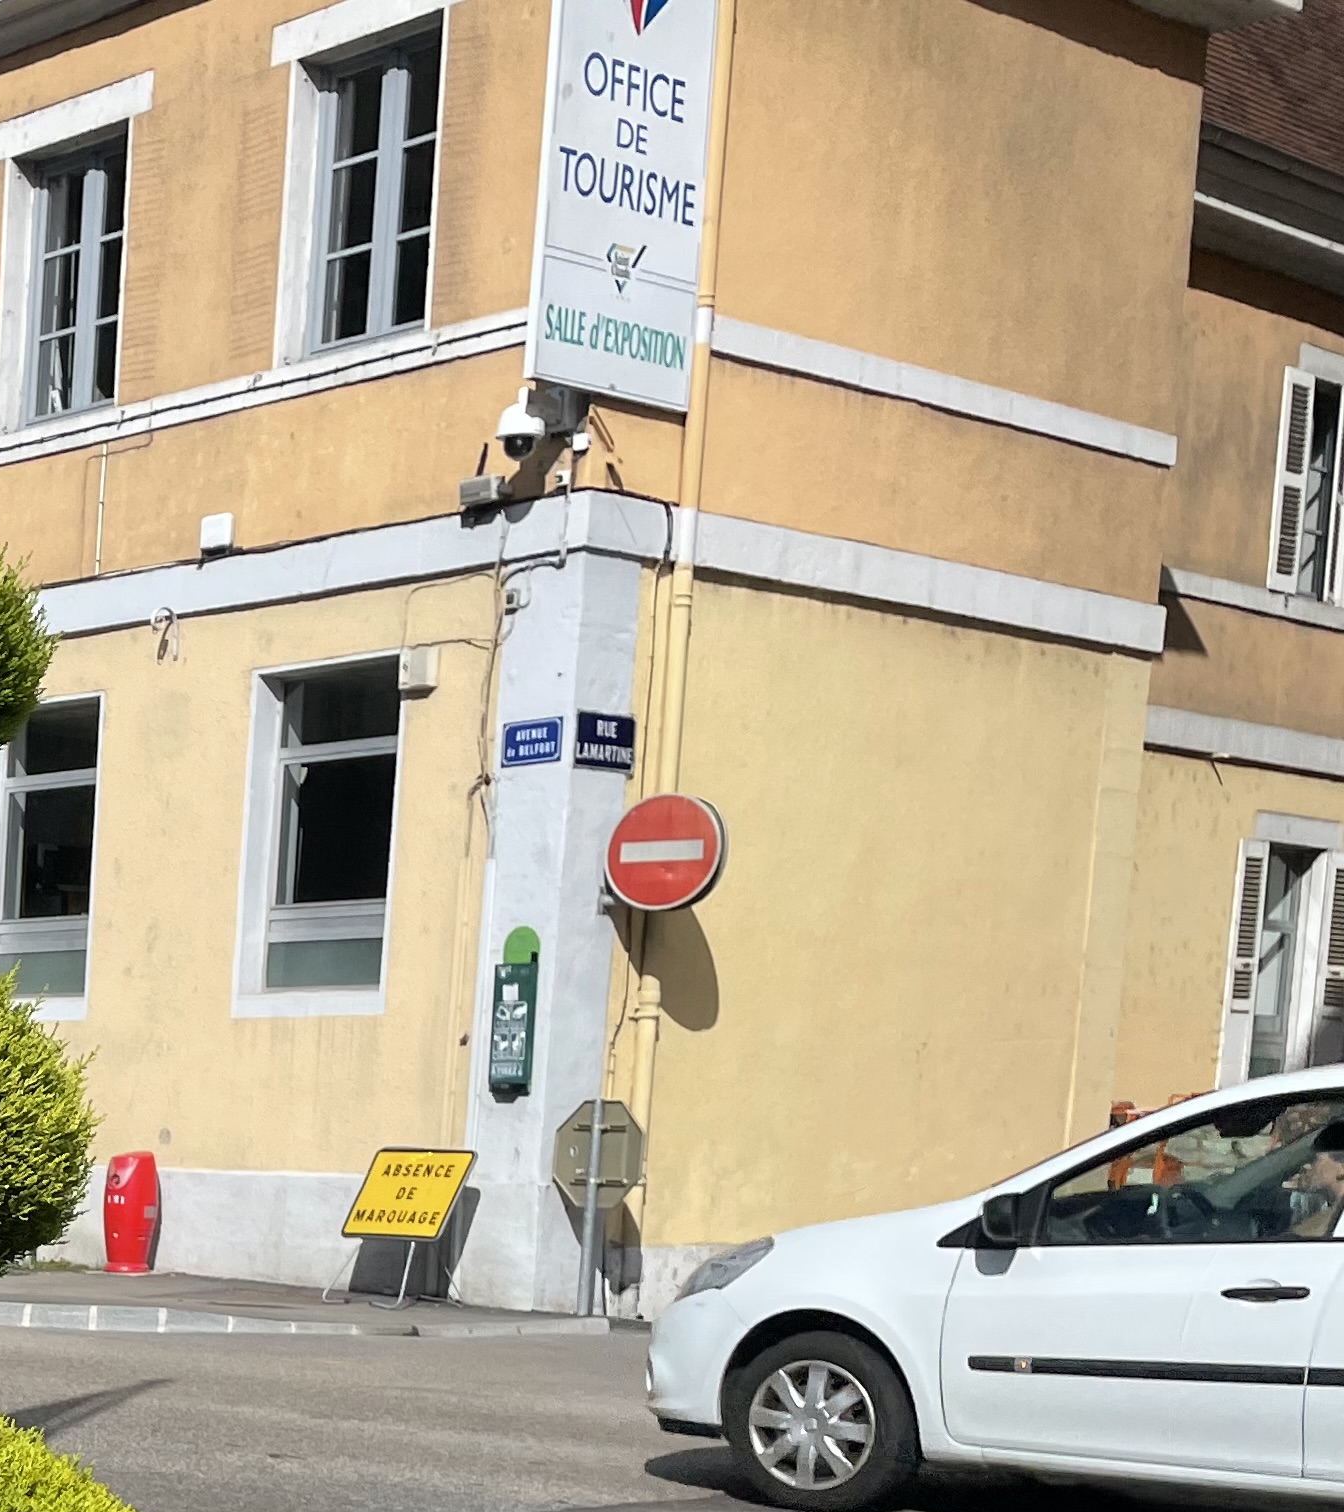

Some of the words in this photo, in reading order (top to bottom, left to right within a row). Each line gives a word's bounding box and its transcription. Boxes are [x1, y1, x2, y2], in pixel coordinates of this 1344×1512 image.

[584, 51, 686, 123] OFFICE
[616, 118, 648, 155] DE
[559, 146, 697, 227] TOURISME
[544, 303, 586, 347] SALLE
[590, 313, 686, 371] d'EXPOSITION
[516, 727, 548, 741] AVENUE
[596, 719, 618, 739] RUE
[519, 741, 556, 756] BELFORT
[575, 742, 632, 764] LAMARTINE
[382, 1164, 456, 1178] ABSENCE
[395, 1187, 418, 1200] DE
[352, 1209, 441, 1226] MARQUAGE
